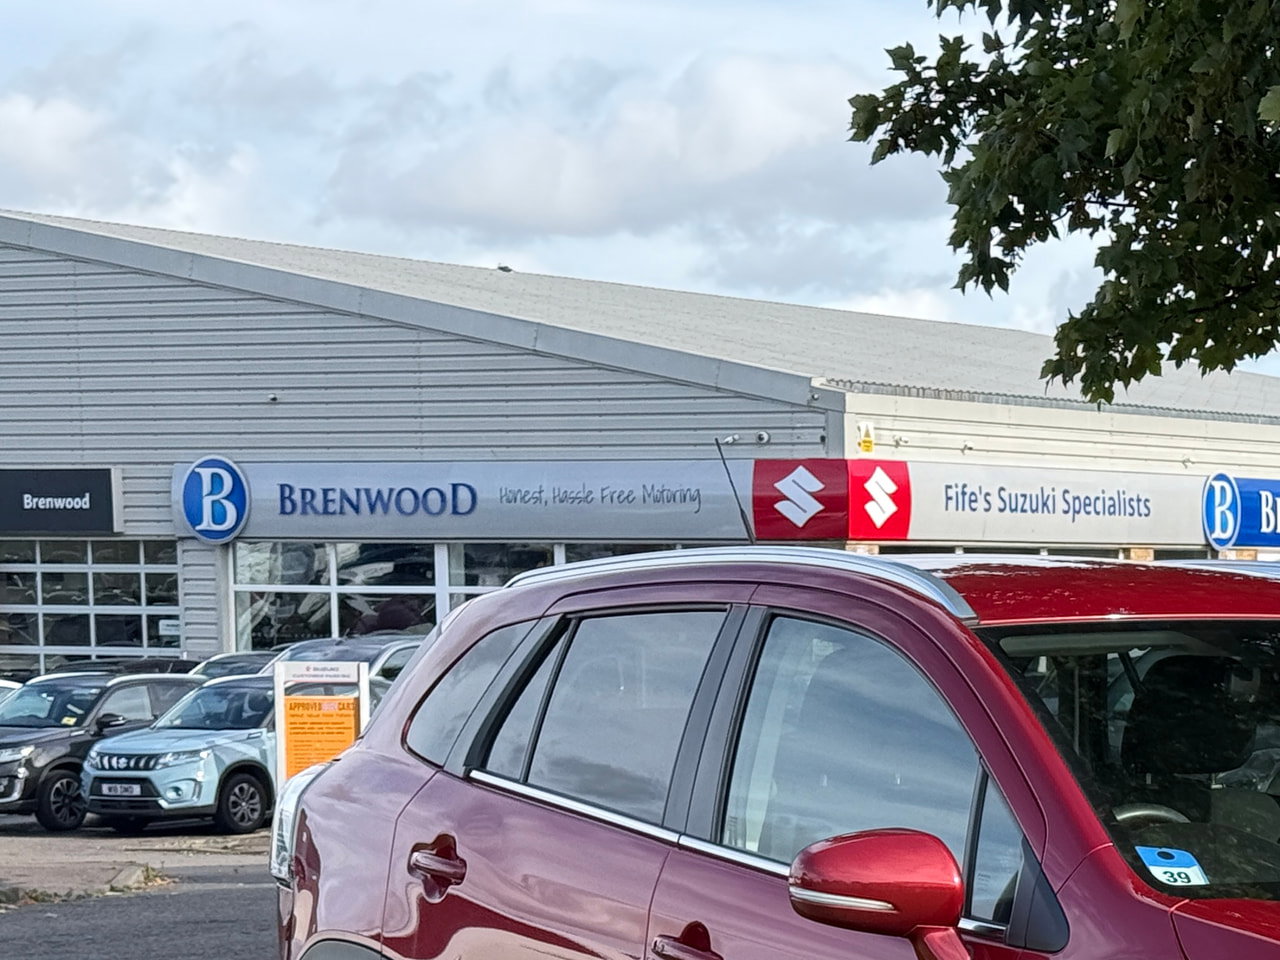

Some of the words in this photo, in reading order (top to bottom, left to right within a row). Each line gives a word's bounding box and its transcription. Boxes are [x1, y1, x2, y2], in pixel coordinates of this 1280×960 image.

[23, 492, 91, 510] Brenwood
[195, 467, 238, 532] B
[277, 482, 478, 516] BRENWOOD
[499, 485, 548, 506] Honest,
[552, 483, 594, 505] Hassle
[600, 485, 636, 505] Free
[642, 484, 702, 514] Motoring
[944, 483, 992, 512] Fife's
[997, 486, 1056, 515] Suzuki
[1062, 488, 1152, 523] Specialists
[1210, 480, 1235, 540] B
[1162, 870, 1192, 884] 39
